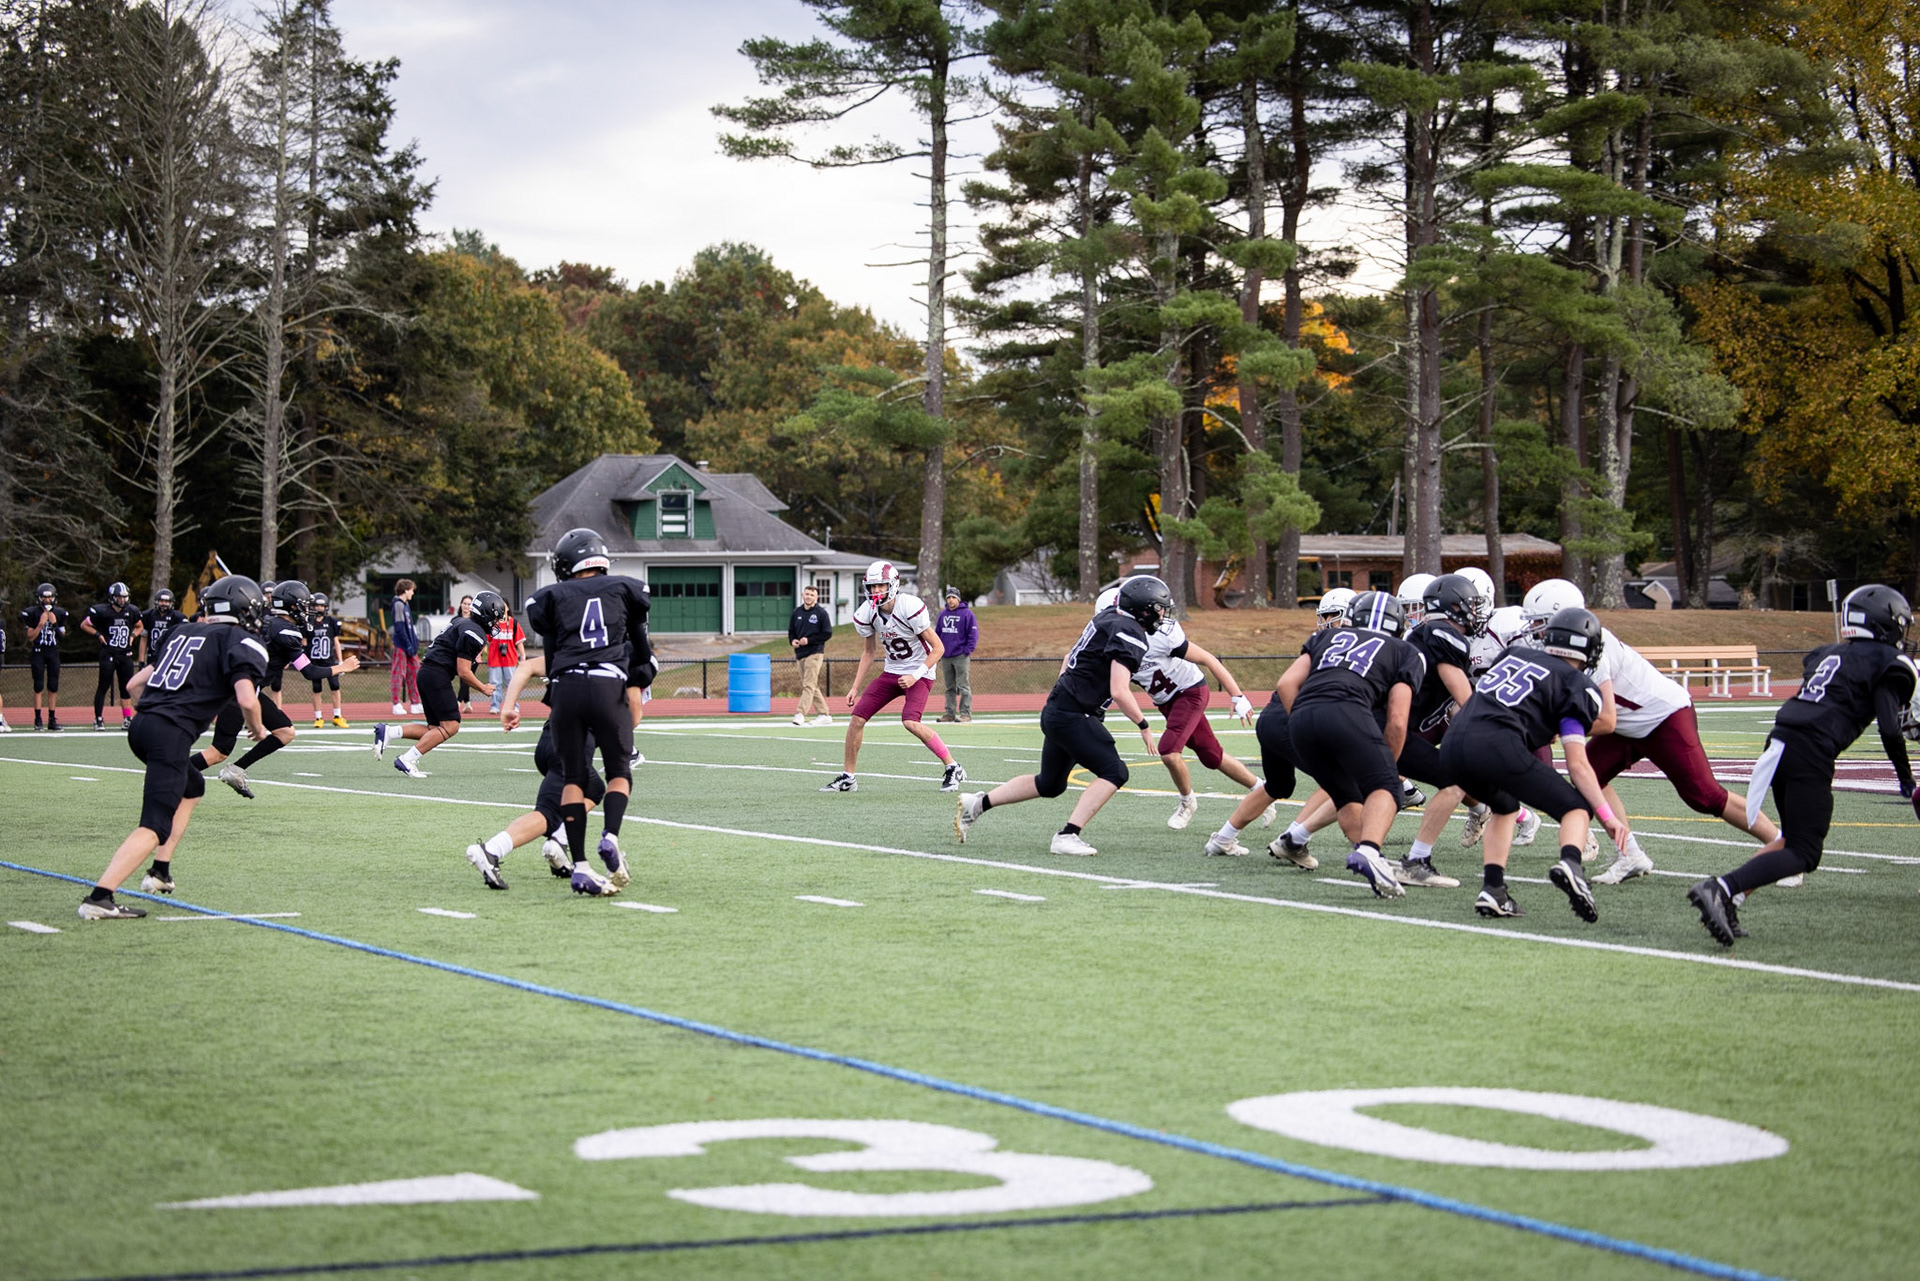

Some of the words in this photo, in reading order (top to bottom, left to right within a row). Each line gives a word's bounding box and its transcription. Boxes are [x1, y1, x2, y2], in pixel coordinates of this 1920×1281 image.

[108, 626, 130, 649] 78
[579, 597, 608, 649] 4
[943, 615, 960, 629] VT
[147, 634, 206, 691] 15
[310, 637, 331, 659] 20
[882, 637, 913, 661] 19
[1317, 631, 1385, 678] 24
[1469, 656, 1483, 666] MS
[1475, 654, 1551, 707] 55
[1798, 655, 1841, 703] 2
